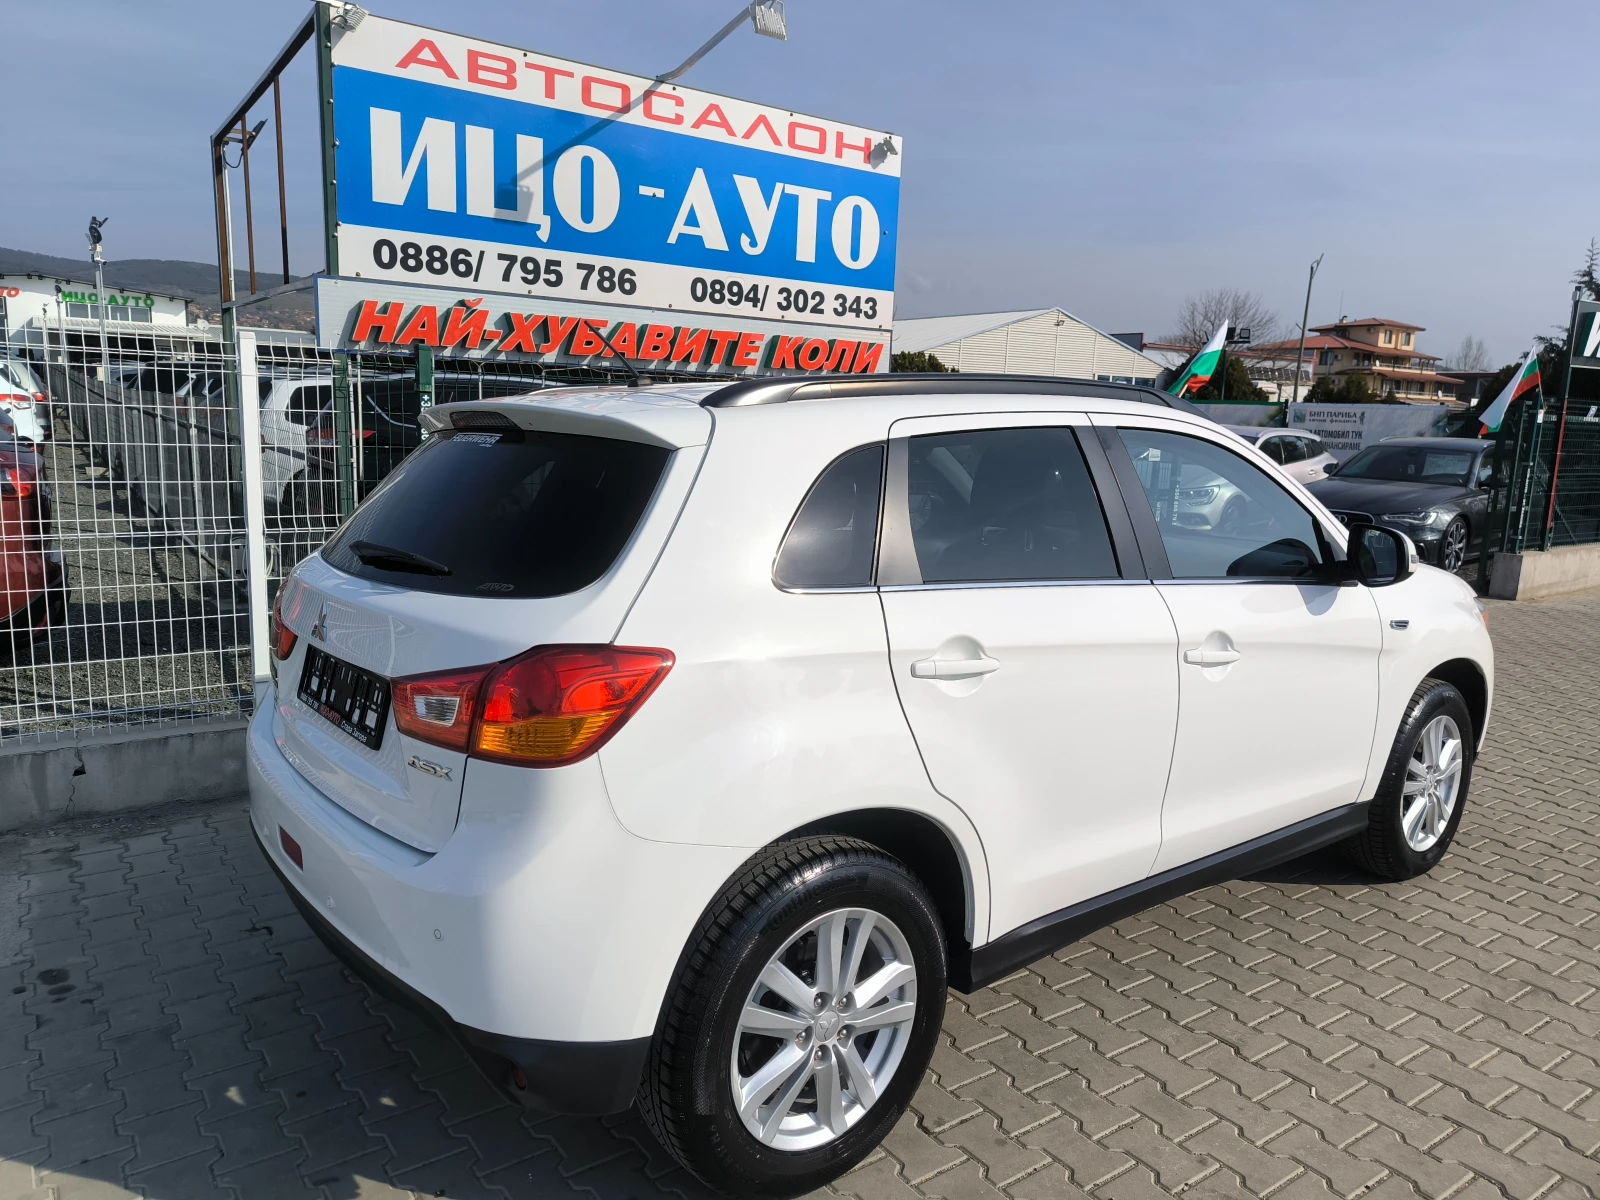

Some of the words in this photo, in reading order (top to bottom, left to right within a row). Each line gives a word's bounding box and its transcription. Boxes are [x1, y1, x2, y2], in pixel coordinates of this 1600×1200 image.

[395, 38, 872, 165] АВТОСАЛОН
[373, 239, 485, 283] 0886/
[497, 252, 563, 288] 795
[576, 262, 637, 295] 786
[690, 276, 769, 312] 0894/
[777, 287, 825, 315] 302
[833, 293, 878, 320] 343
[352, 297, 765, 367] НАЙ-ХУБАВИТЕ
[771, 335, 884, 374] КОЛИ
[1351, 430, 1363, 439] ТУК
[407, 754, 453, 782] ASX
